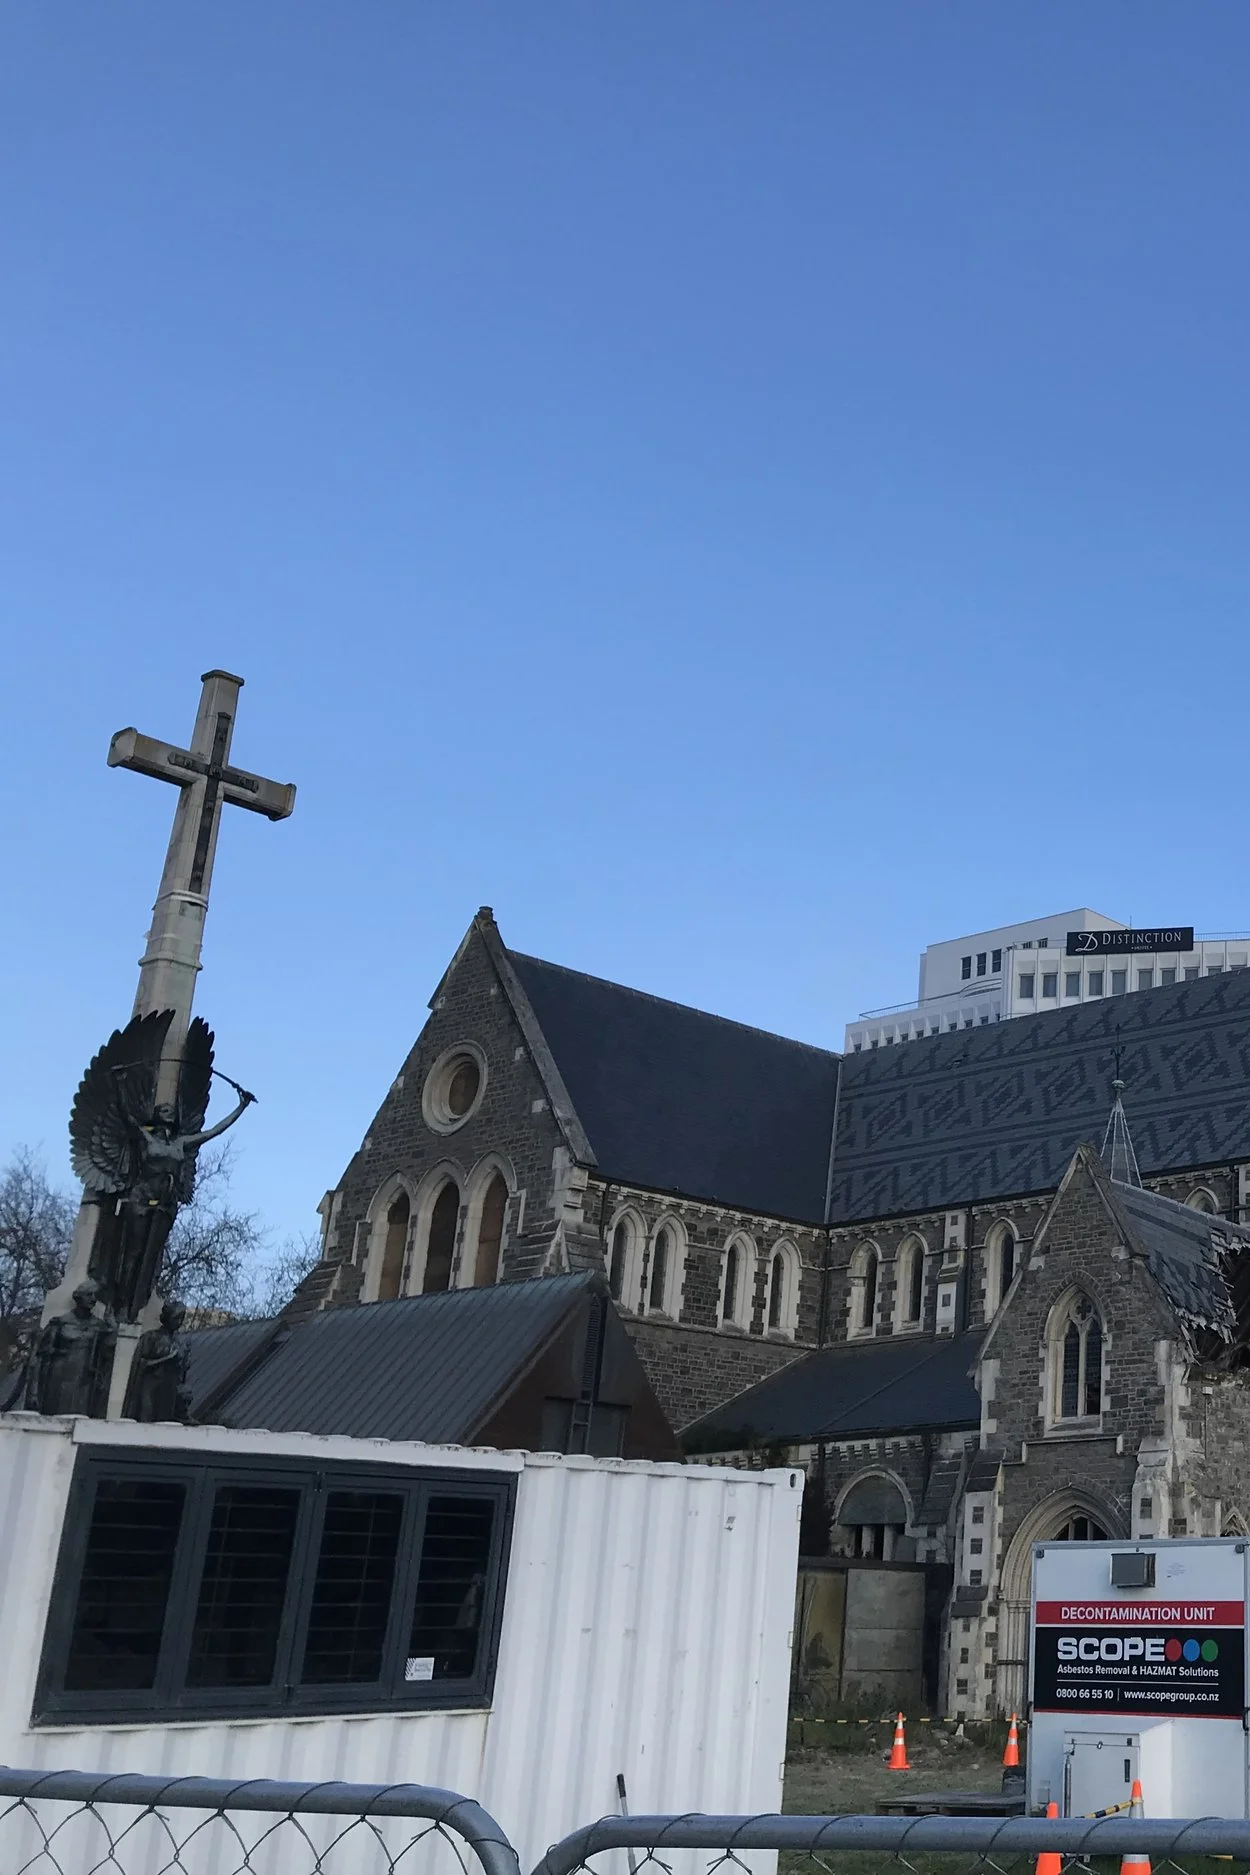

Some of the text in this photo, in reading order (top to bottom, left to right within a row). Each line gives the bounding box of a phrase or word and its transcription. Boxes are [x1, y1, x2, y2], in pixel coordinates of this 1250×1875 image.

[1102, 931, 1182, 945] DISTINCTION
[1061, 1606, 1215, 1620] DECONTAMINATION UNIT
[1057, 1637, 1166, 1661] SCOPE
[1057, 1664, 1219, 1677] Asbestos Removal & HAZMAT Solutions
[1056, 1688, 1220, 1703] 0800 66 55 10 www.scopegroup.co.nz
